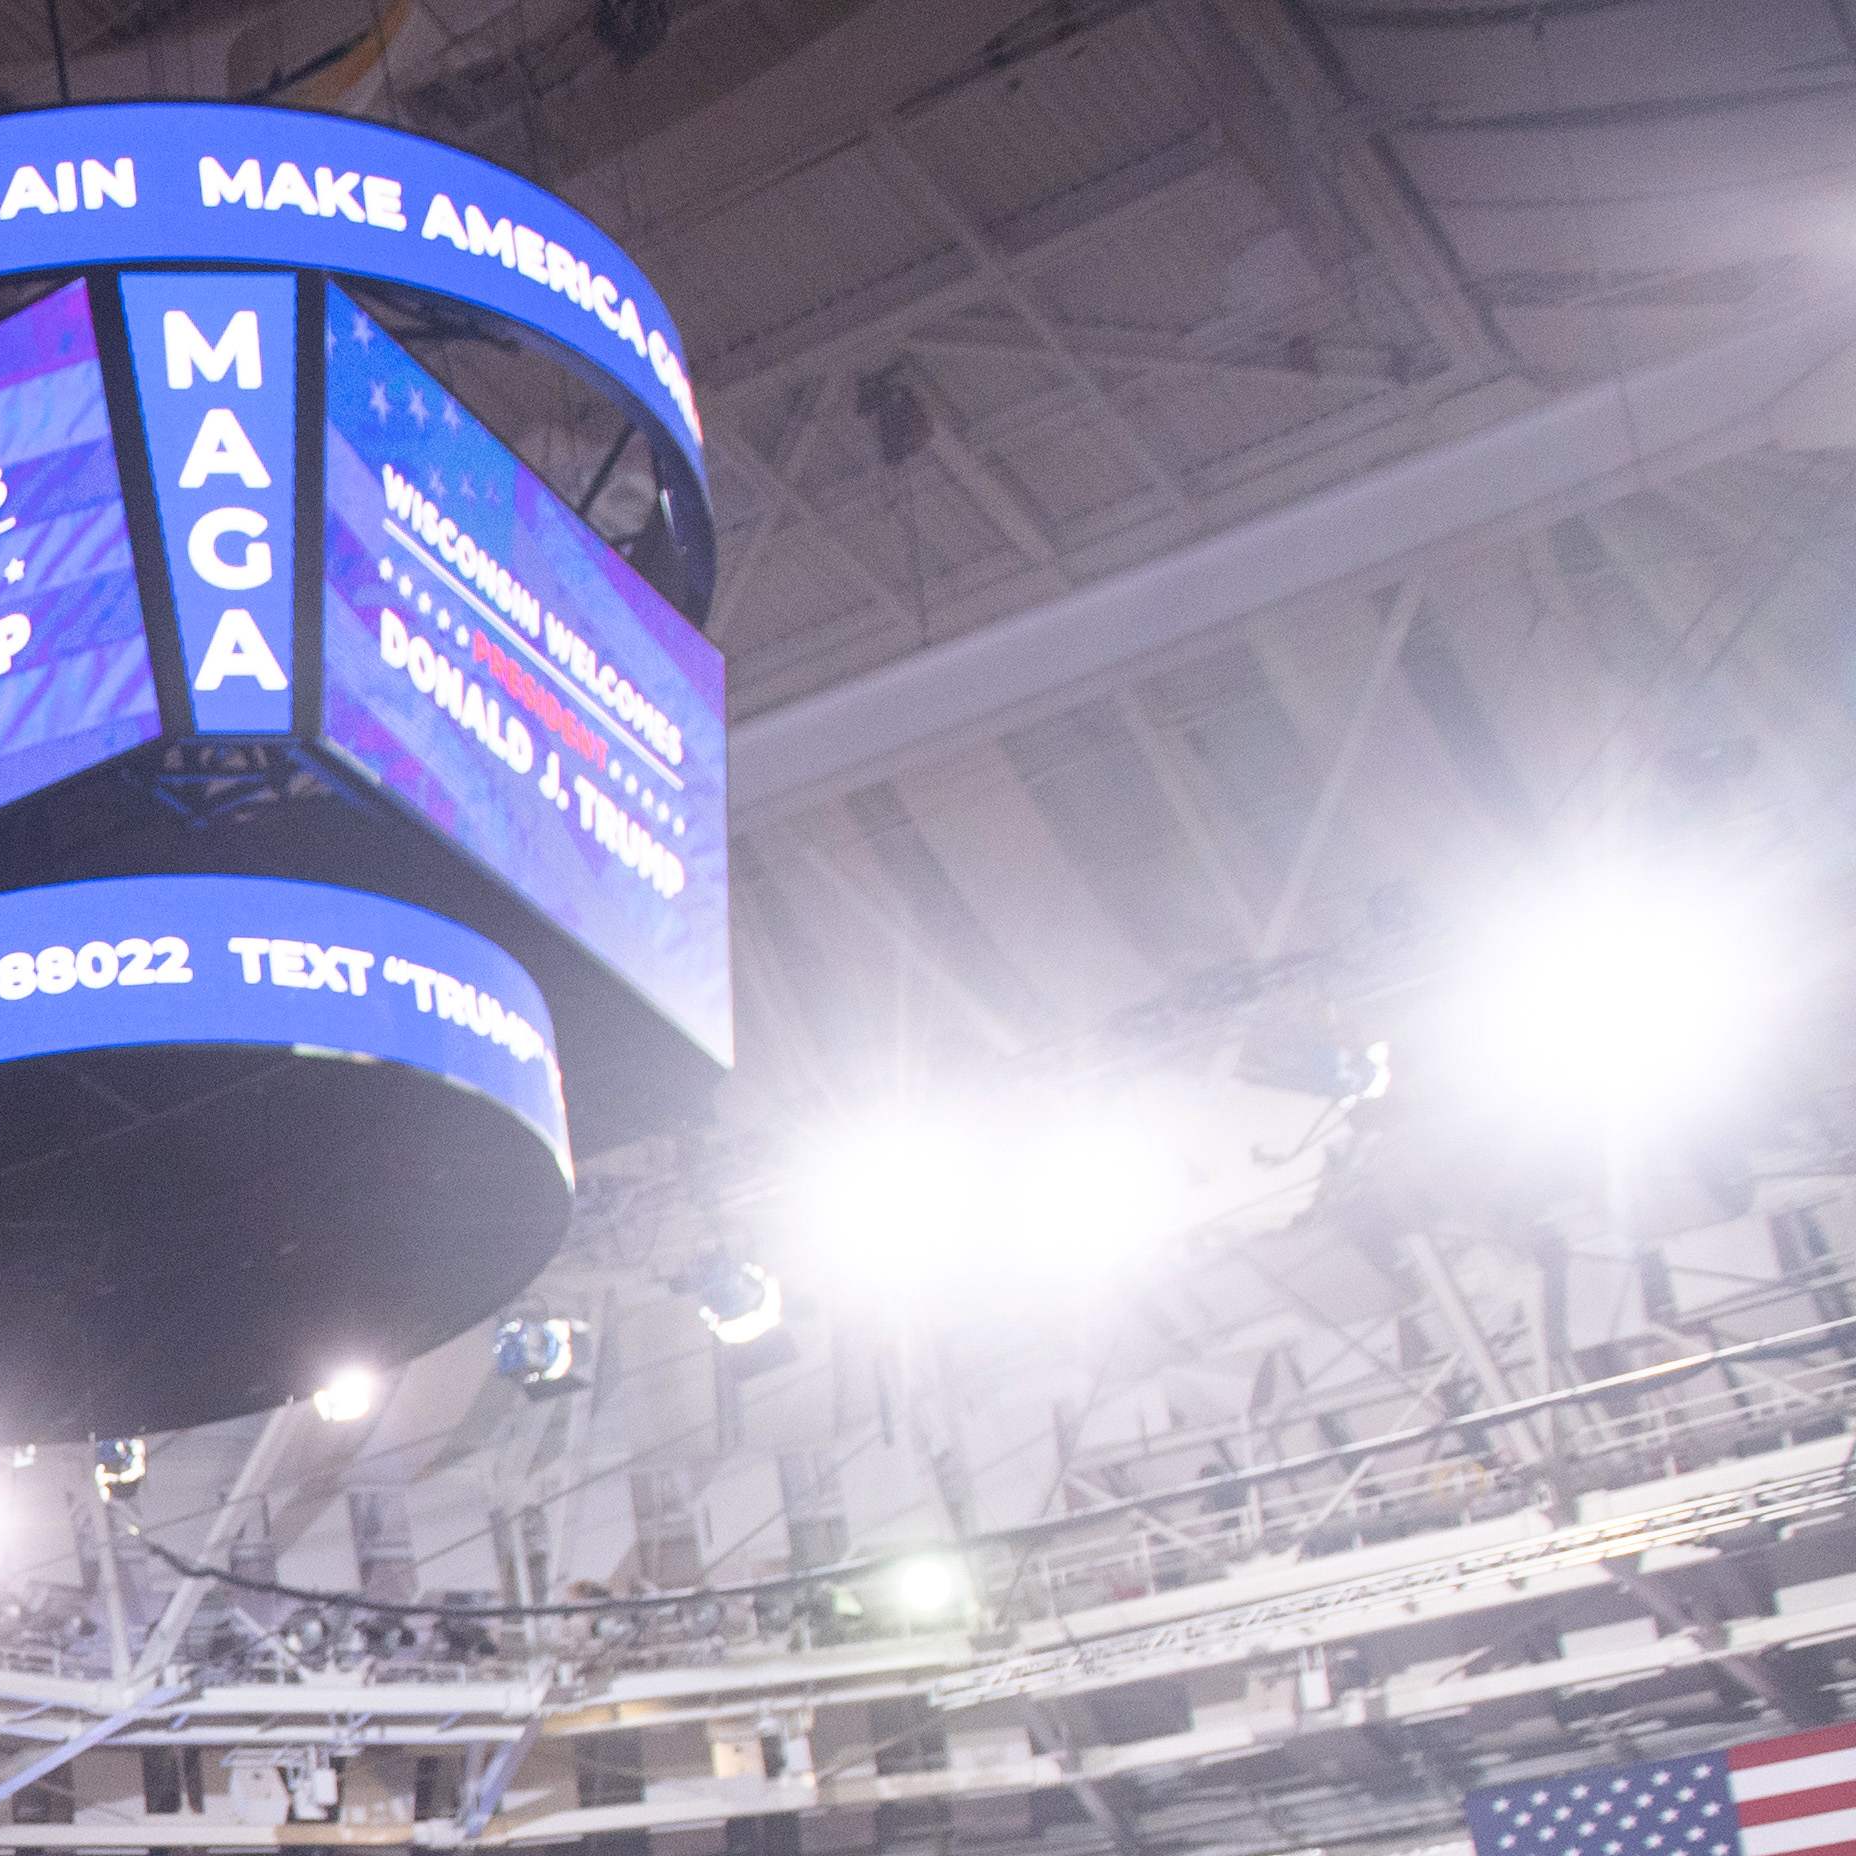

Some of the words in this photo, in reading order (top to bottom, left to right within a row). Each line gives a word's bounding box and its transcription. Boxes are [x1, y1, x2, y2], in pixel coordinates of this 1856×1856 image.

[199, 156, 407, 232] MAKE
[421, 193, 647, 358] AMERICA
[383, 463, 540, 639] WISCONSIN
[544, 611, 683, 766] WELCOMES
[472, 629, 609, 770] PRESIDENT
[380, 608, 533, 774] DONALD
[539, 752, 570, 811] J.
[575, 775, 685, 899] TRUMP
[228, 936, 375, 997] TEXT
